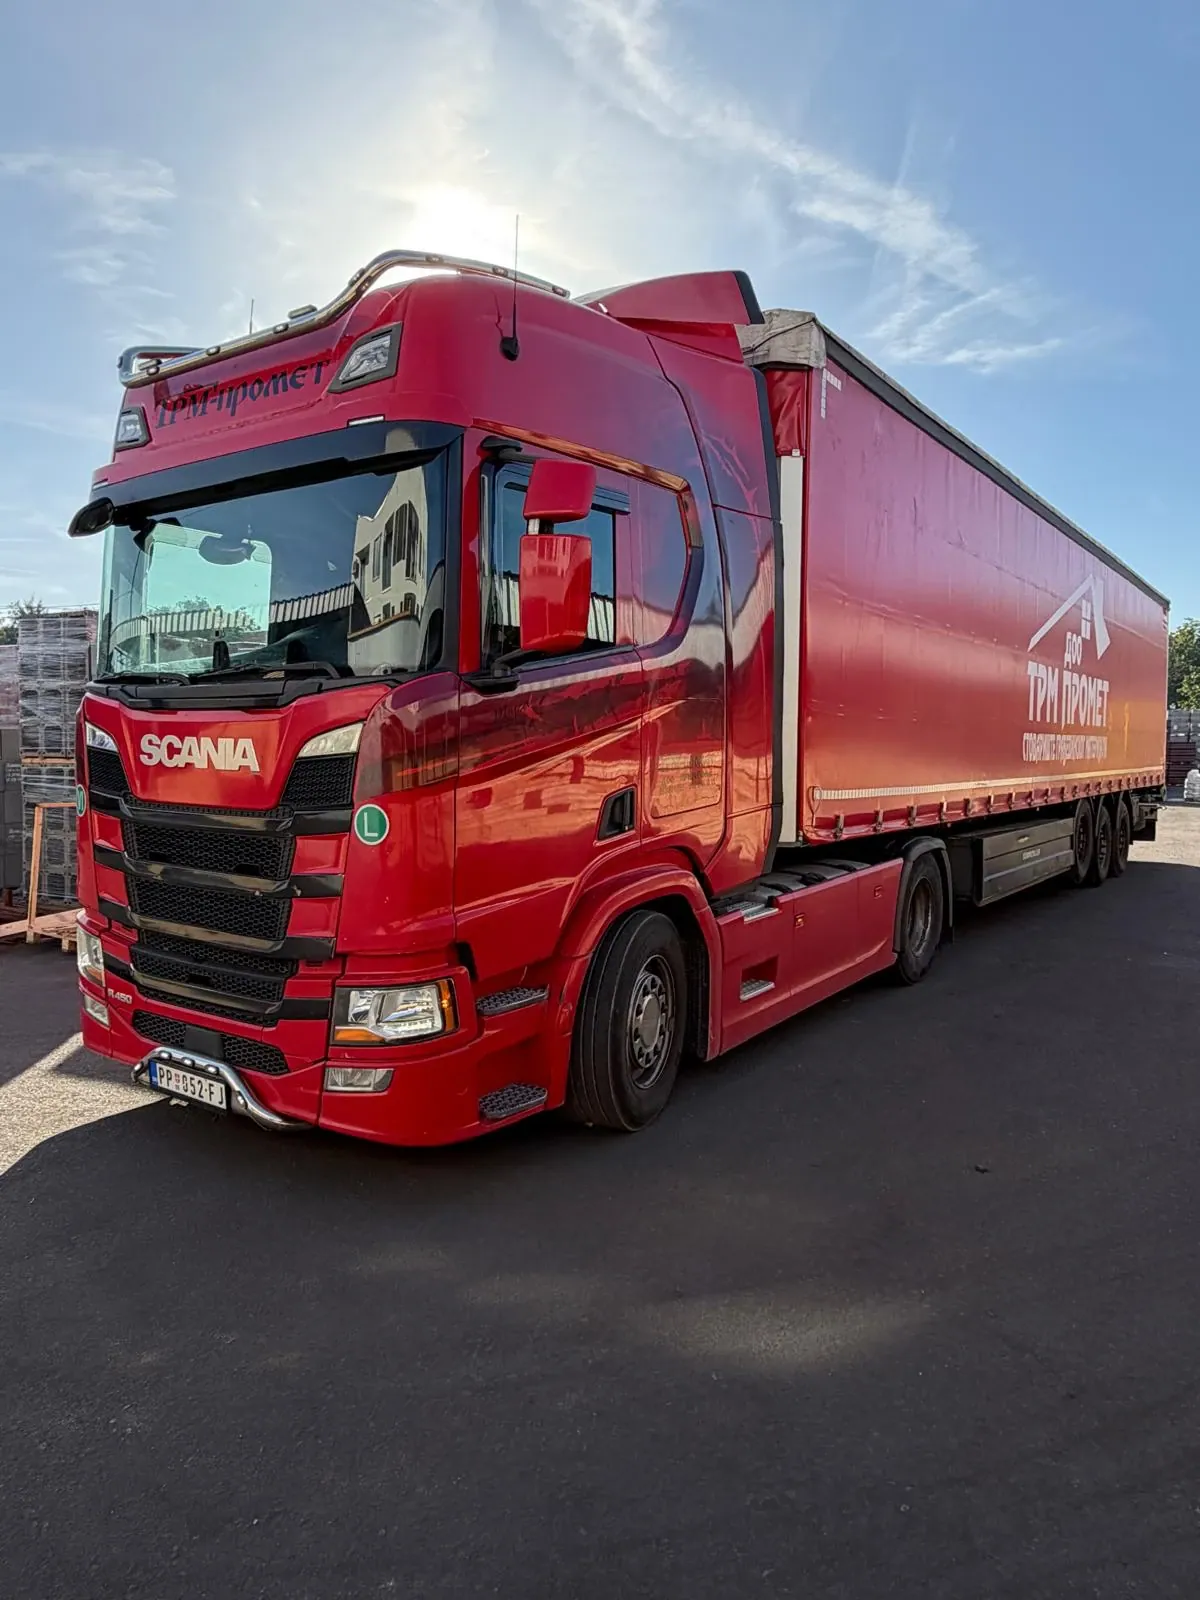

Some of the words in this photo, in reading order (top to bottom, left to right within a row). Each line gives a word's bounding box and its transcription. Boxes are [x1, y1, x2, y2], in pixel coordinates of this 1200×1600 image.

[1027, 660, 1059, 724] ТРМ
[1061, 670, 1110, 731] ПРОМЕТ
[139, 733, 261, 772] SCANIA
[363, 812, 379, 837] L
[158, 1067, 173, 1087] PP
